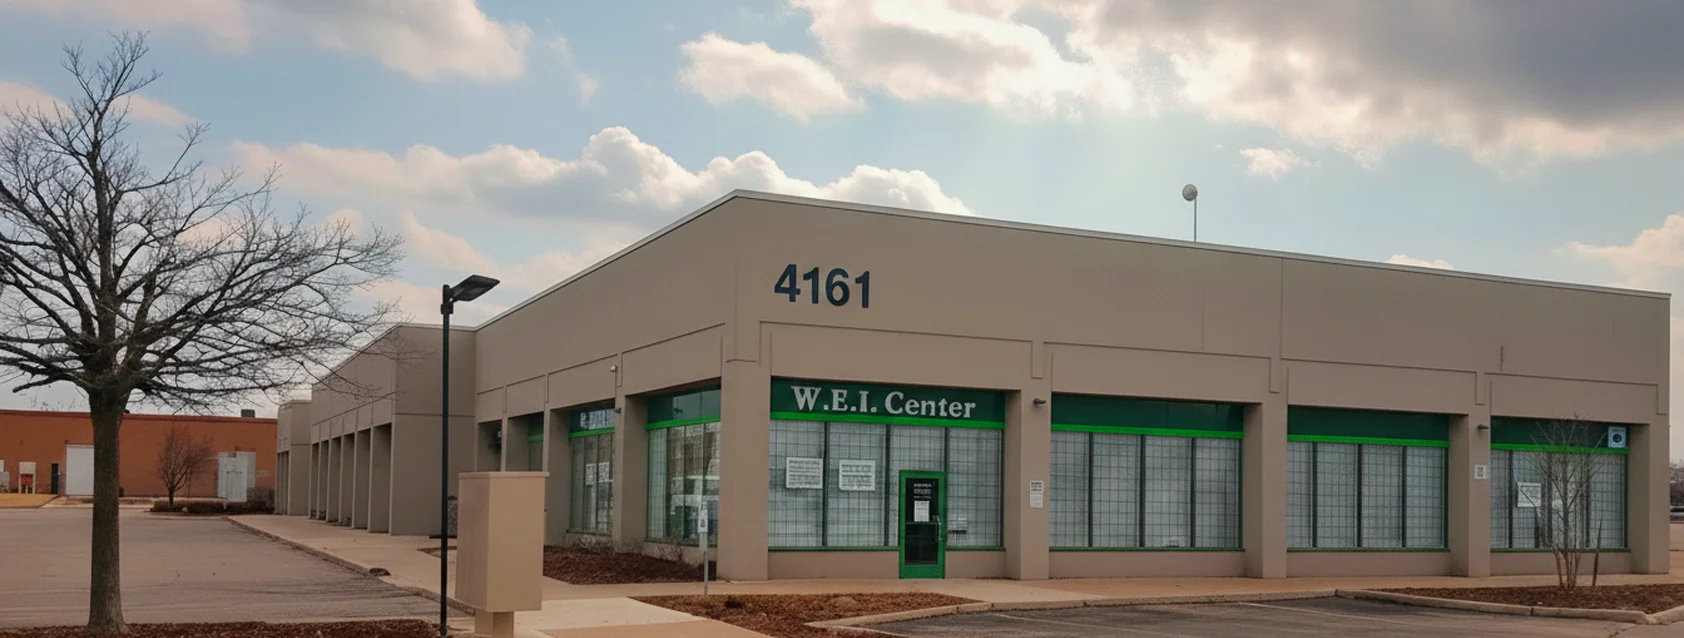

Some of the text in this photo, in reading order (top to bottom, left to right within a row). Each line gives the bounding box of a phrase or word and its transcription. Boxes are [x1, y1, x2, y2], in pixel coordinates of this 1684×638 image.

[774, 264, 870, 308] 4161
[791, 385, 976, 418] W.E.I. Center
